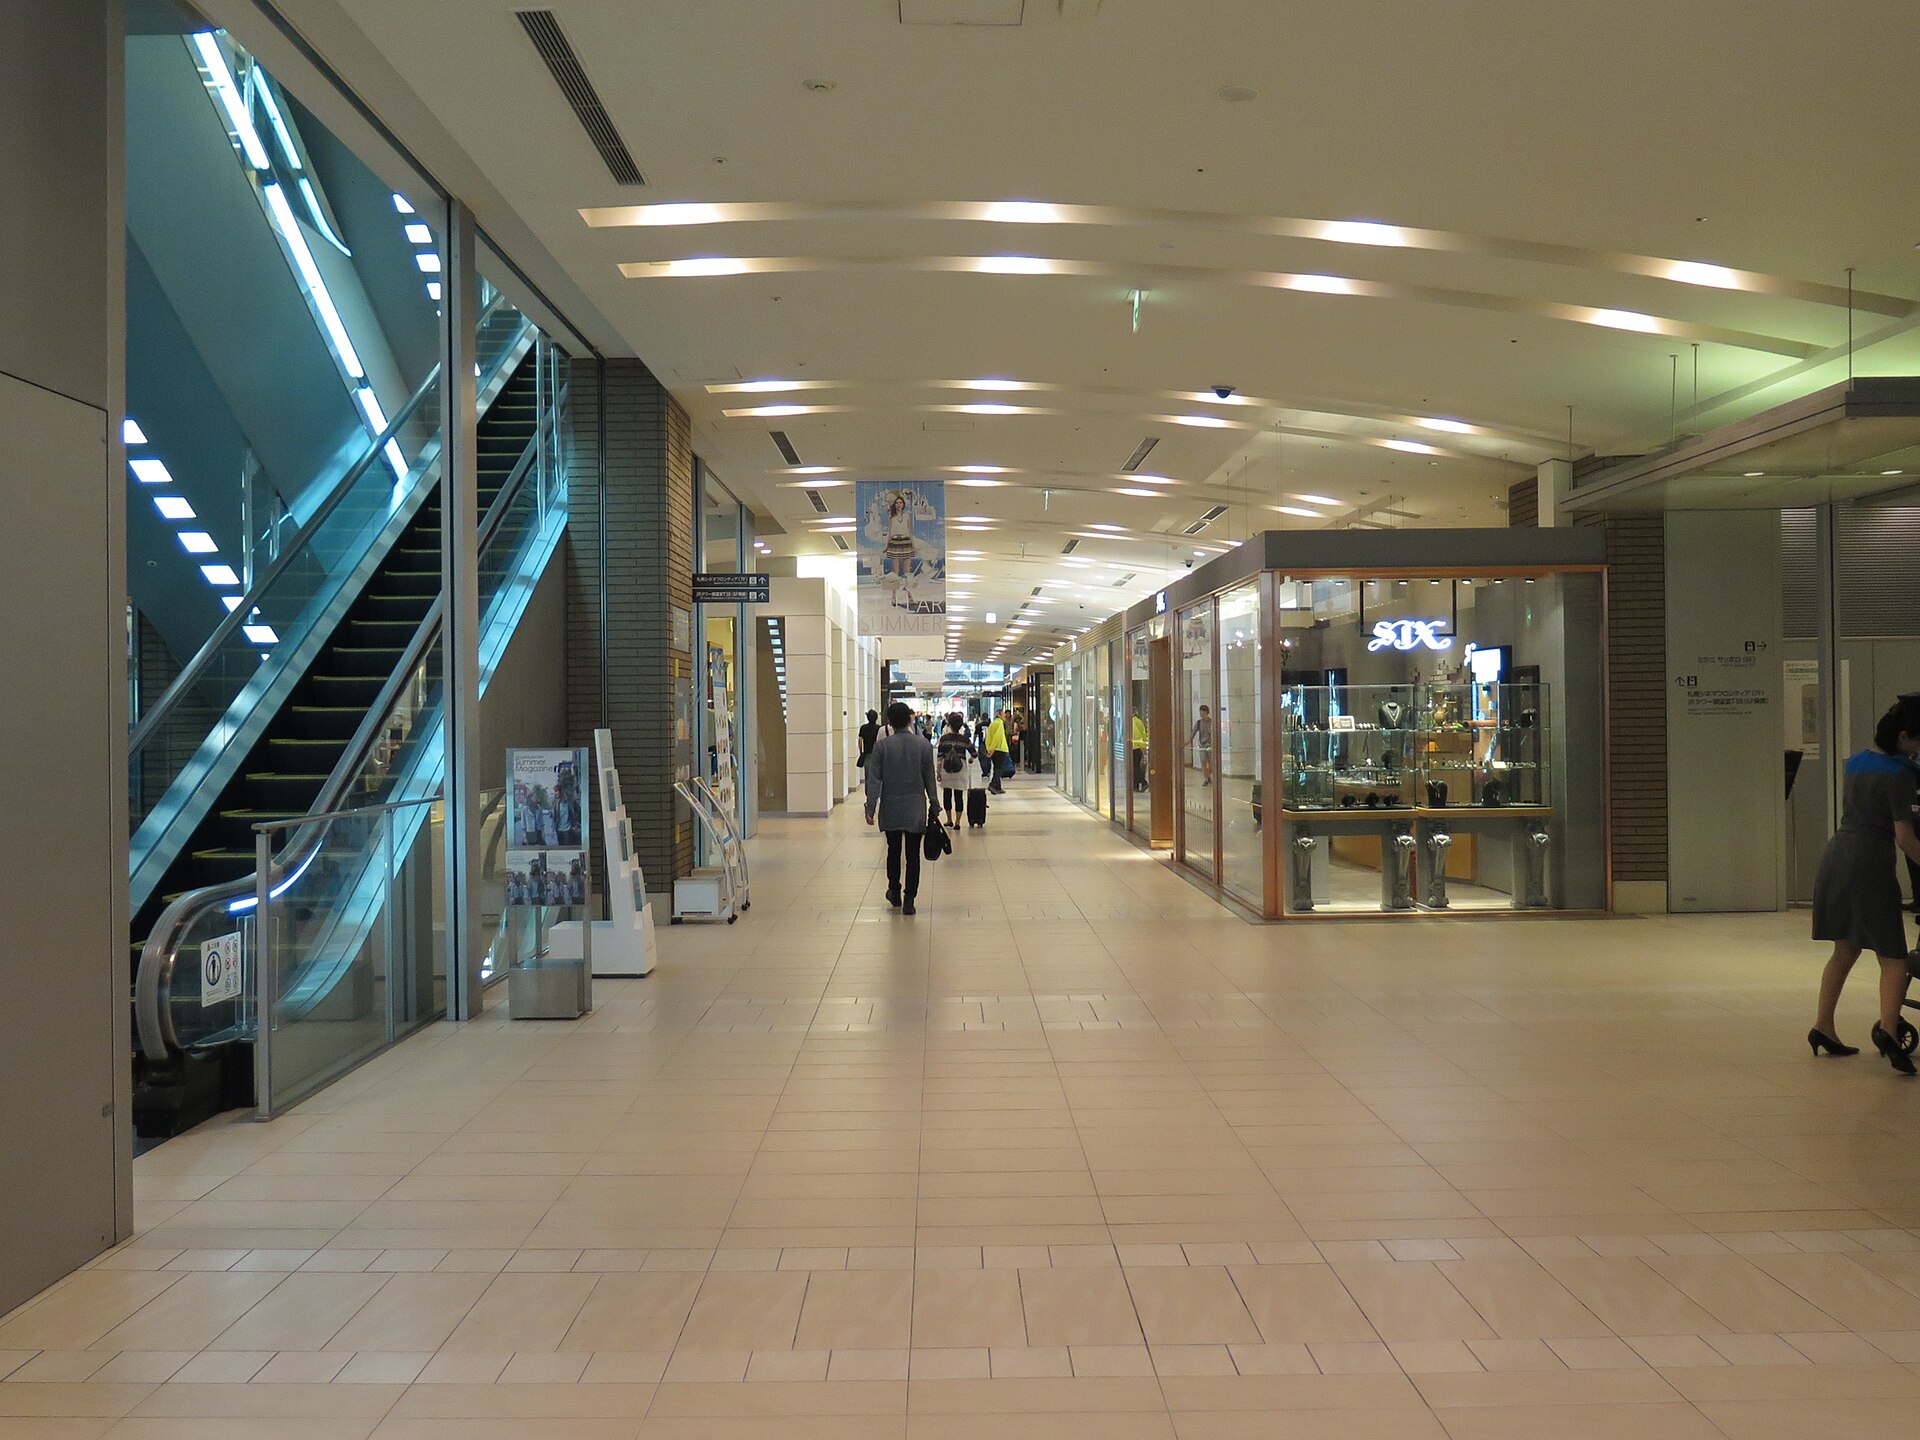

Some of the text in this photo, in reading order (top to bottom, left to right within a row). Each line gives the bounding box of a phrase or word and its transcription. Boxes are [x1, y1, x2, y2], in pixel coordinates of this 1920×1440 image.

[861, 616, 943, 632] SUMMER
[515, 758, 546, 766] Summer
[515, 765, 553, 774] Magazine
